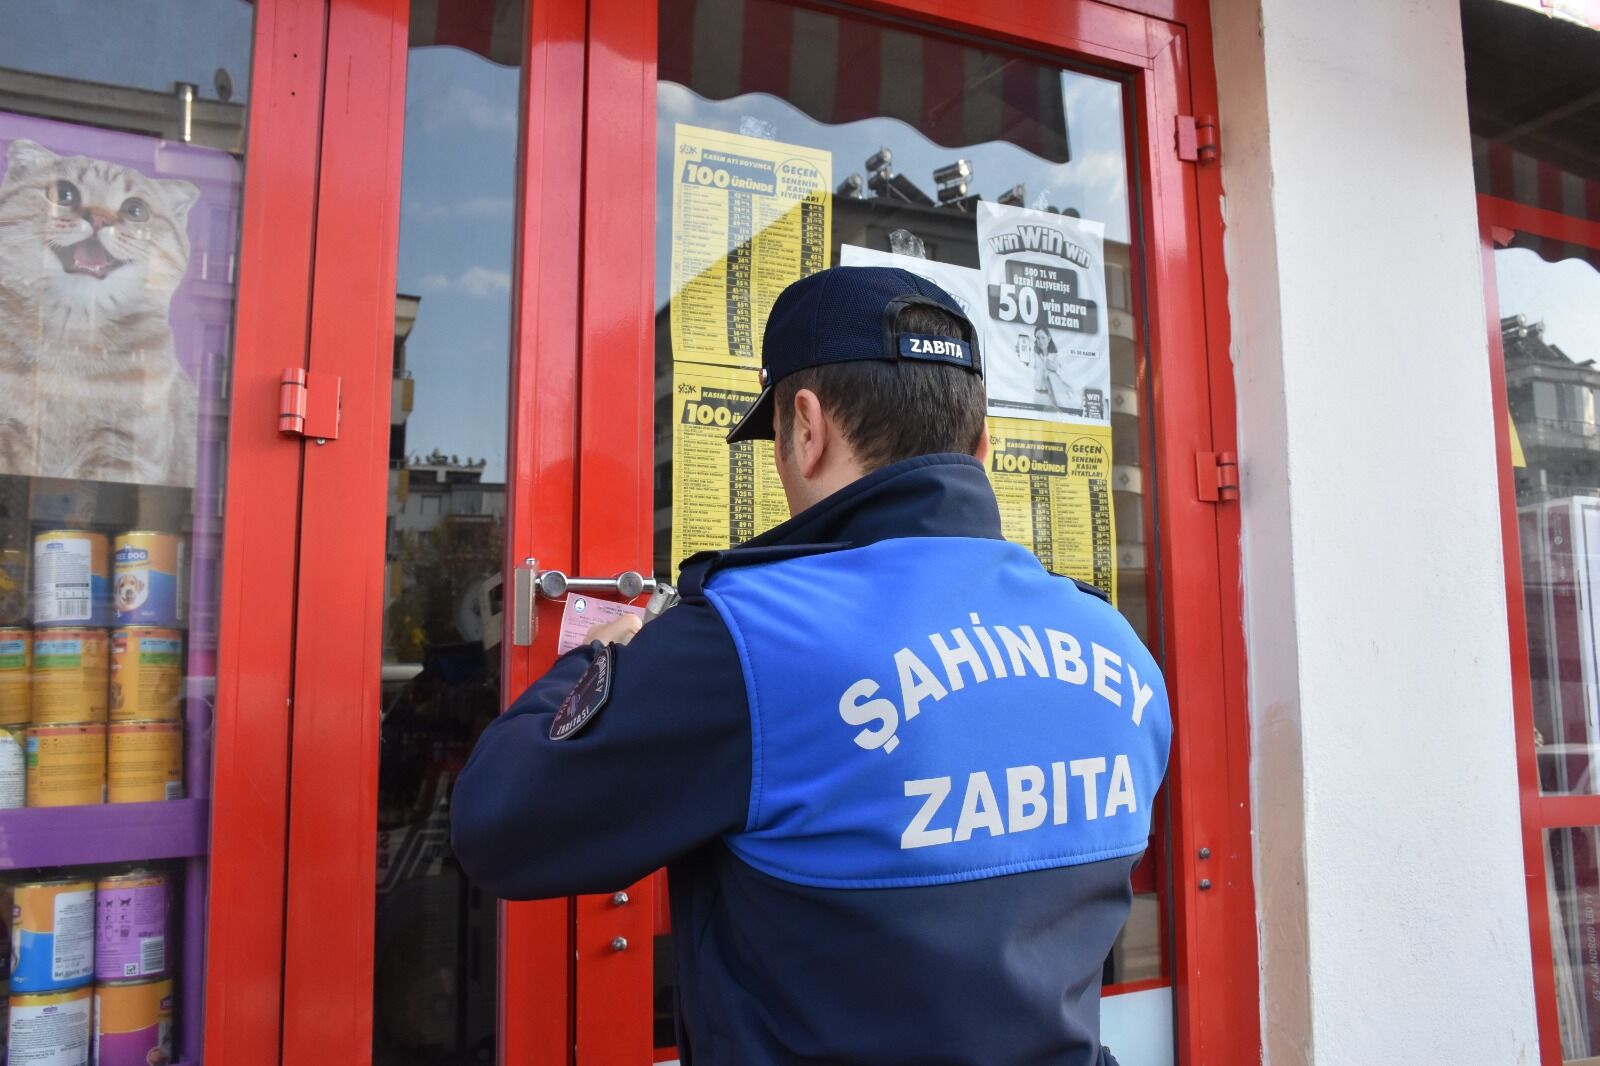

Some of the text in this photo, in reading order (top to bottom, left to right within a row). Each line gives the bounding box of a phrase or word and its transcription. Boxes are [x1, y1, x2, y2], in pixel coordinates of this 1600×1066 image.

[687, 164, 774, 193] 100 ÜRÜNDE
[1024, 267, 1057, 280] 500 TL VE
[998, 283, 1039, 325] 50
[1042, 298, 1087, 316] win para
[1047, 311, 1080, 329] kazan
[909, 338, 963, 359] ZABITA
[703, 391, 726, 400] KASIM
[687, 403, 732, 427] 100
[1071, 455, 1103, 464] SENENİN
[1072, 444, 1102, 456] GEÇEN
[995, 453, 1066, 473] 100 ÜRÜNDE
[838, 612, 1154, 755] ŞAHİNBEY
[900, 754, 1138, 850] ZABITA
[1583, 892, 1593, 905] TV
[1584, 906, 1594, 924] LED
[1587, 926, 1598, 970] ANDROID
